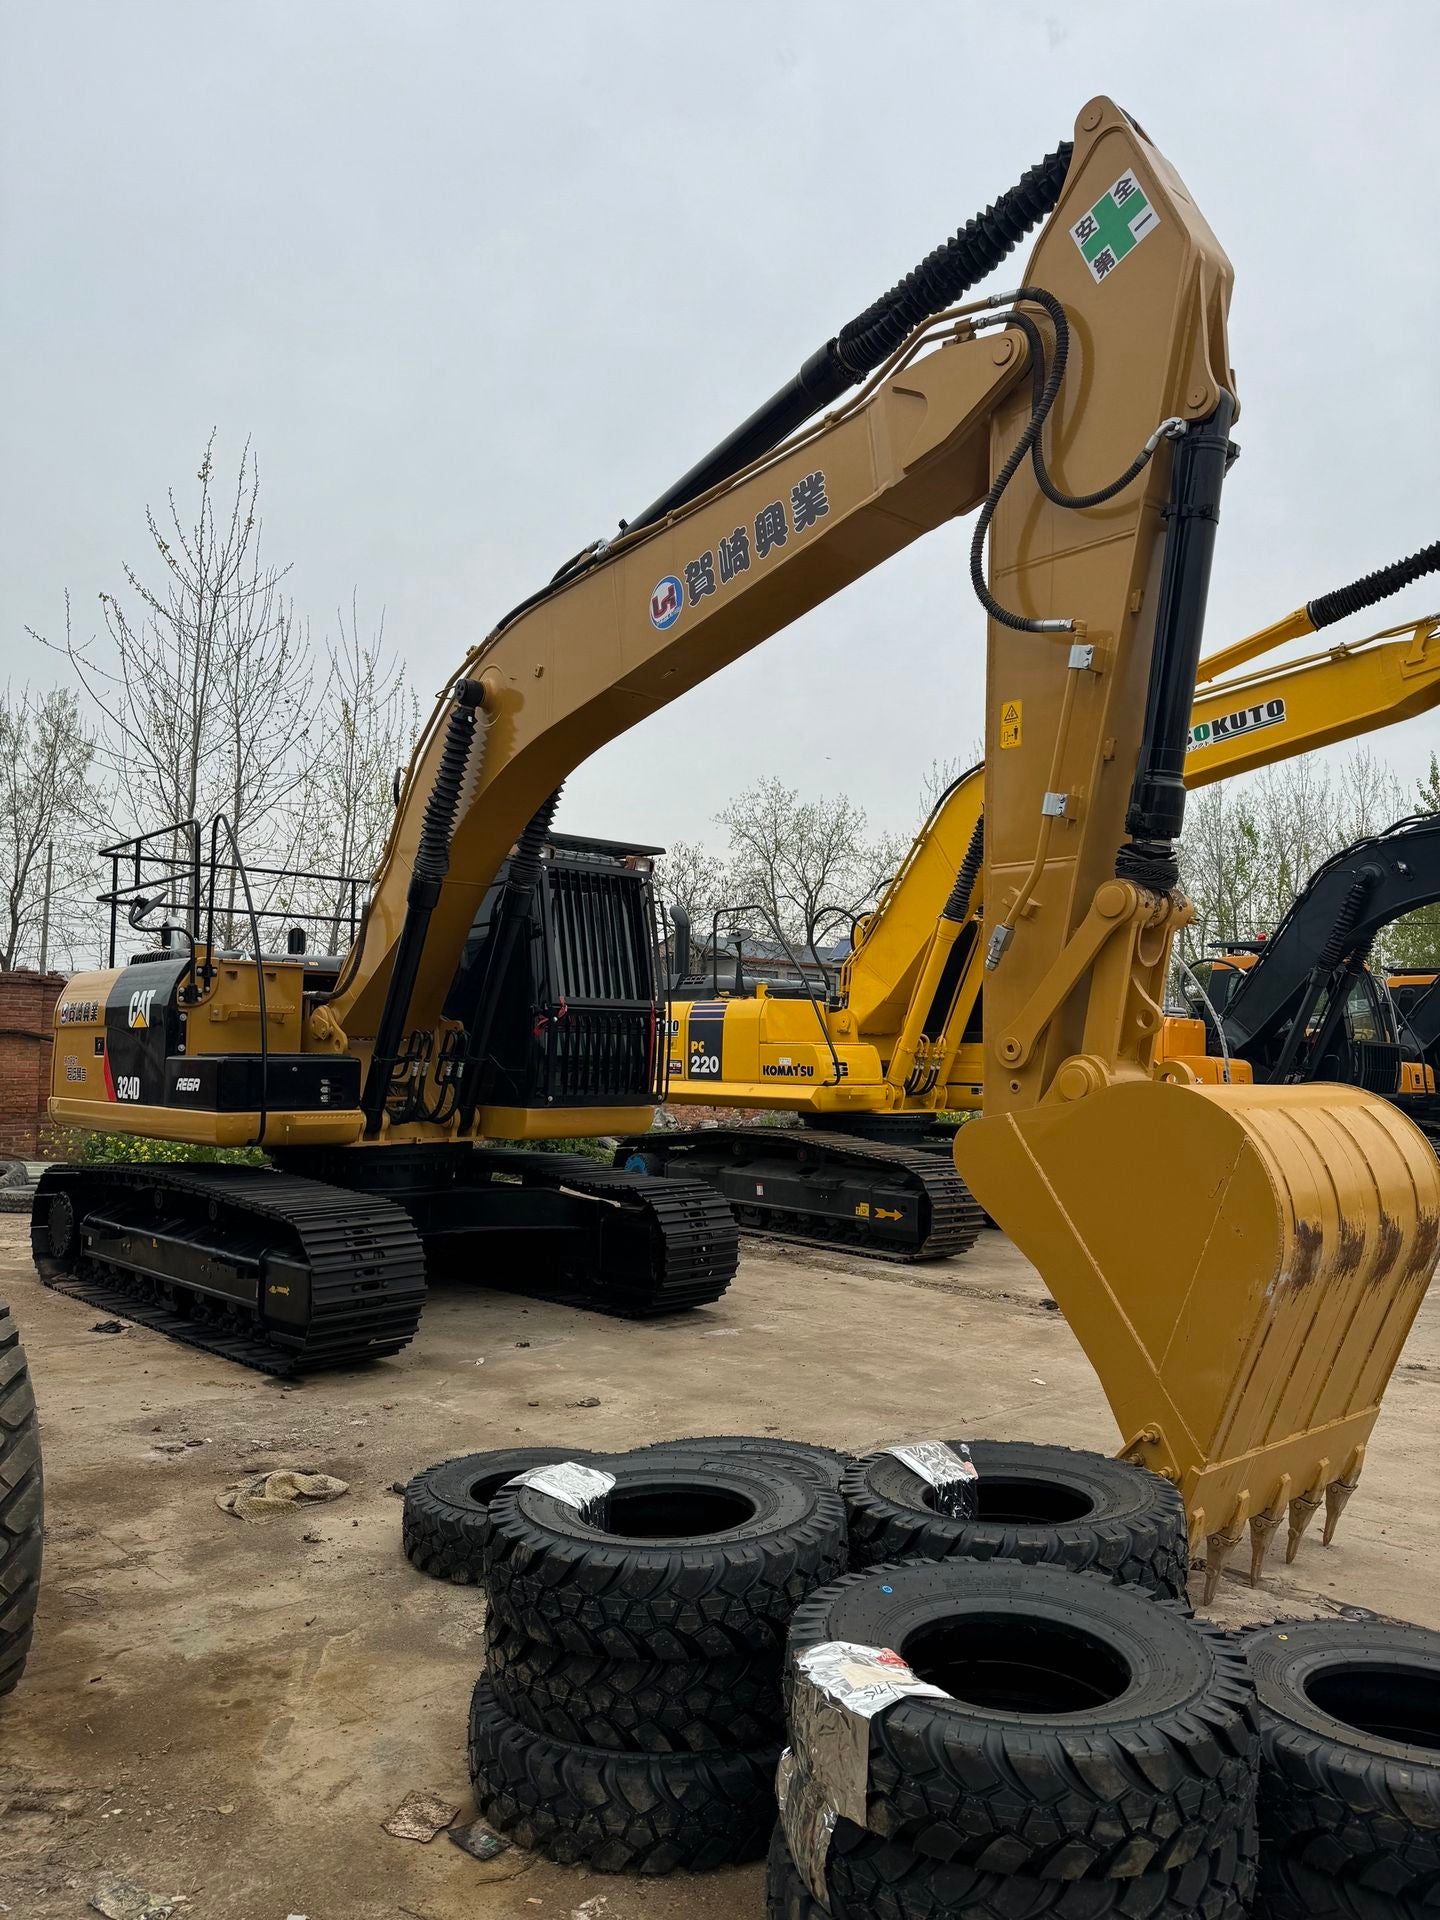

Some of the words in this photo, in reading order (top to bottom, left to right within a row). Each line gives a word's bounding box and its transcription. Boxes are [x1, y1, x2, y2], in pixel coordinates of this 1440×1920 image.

[128, 989, 156, 1028] CAT
[690, 1040, 705, 1054] PC
[690, 1055, 720, 1074] 220
[762, 1063, 815, 1077] KOMATSU
[117, 1076, 140, 1100] 324D
